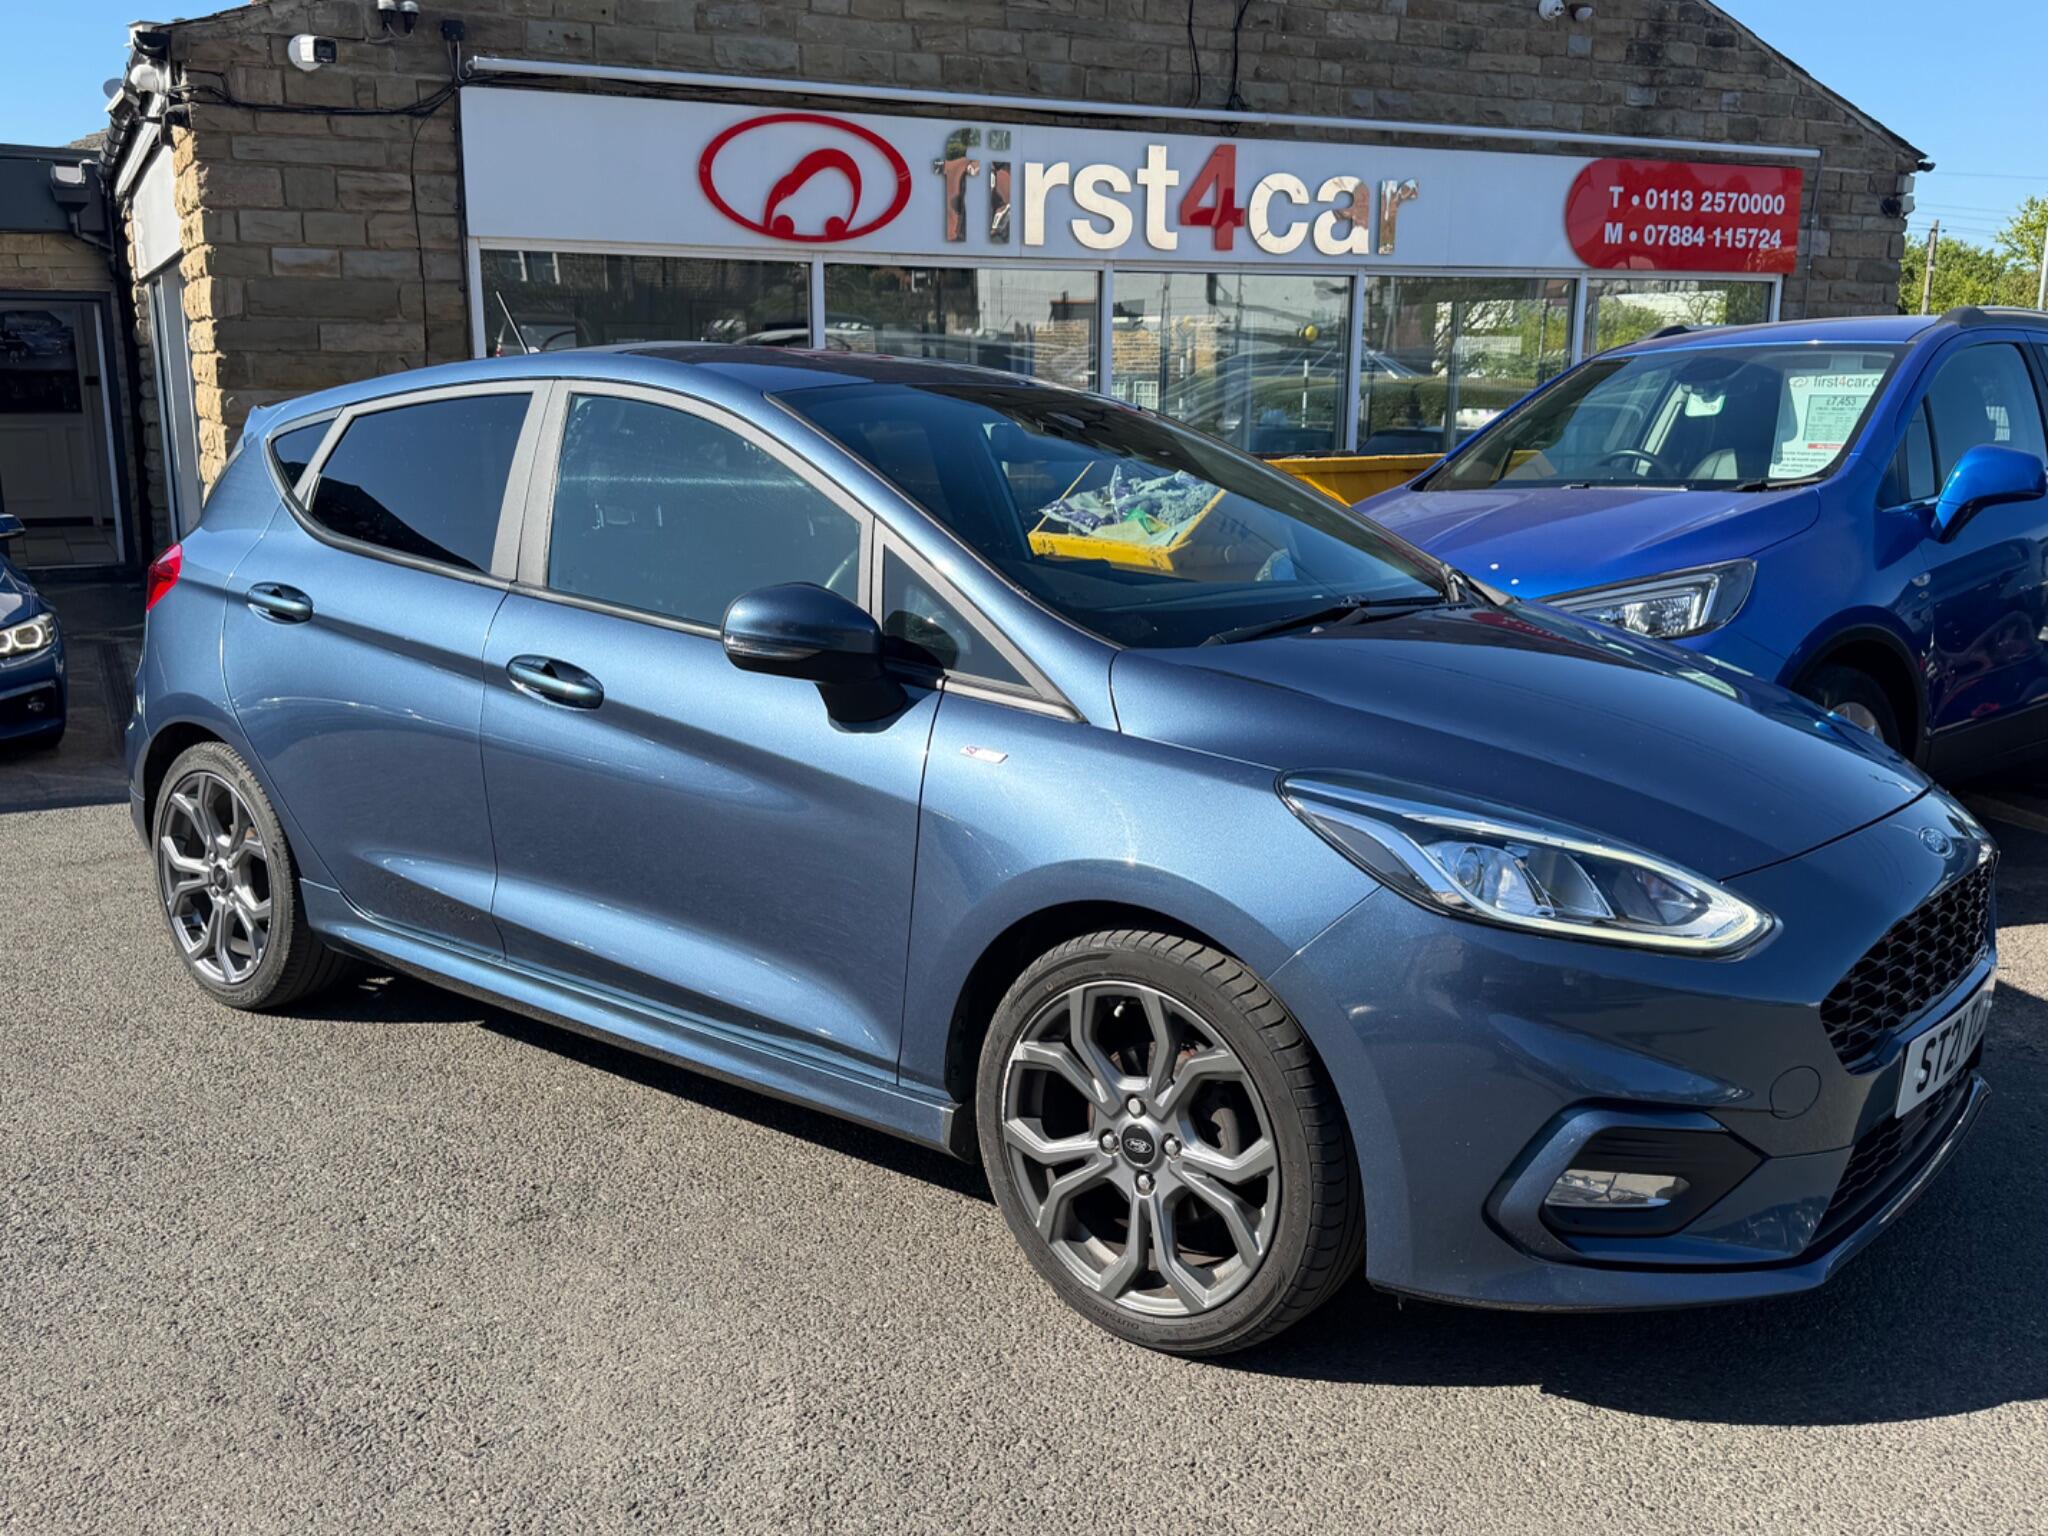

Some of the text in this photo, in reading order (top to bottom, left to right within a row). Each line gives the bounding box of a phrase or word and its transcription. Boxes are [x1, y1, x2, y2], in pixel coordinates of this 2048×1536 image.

[933, 127, 1420, 255] first4car
[1609, 186, 1785, 215] T 0113 2570000
[1604, 222, 1782, 249] M 07884 115724
